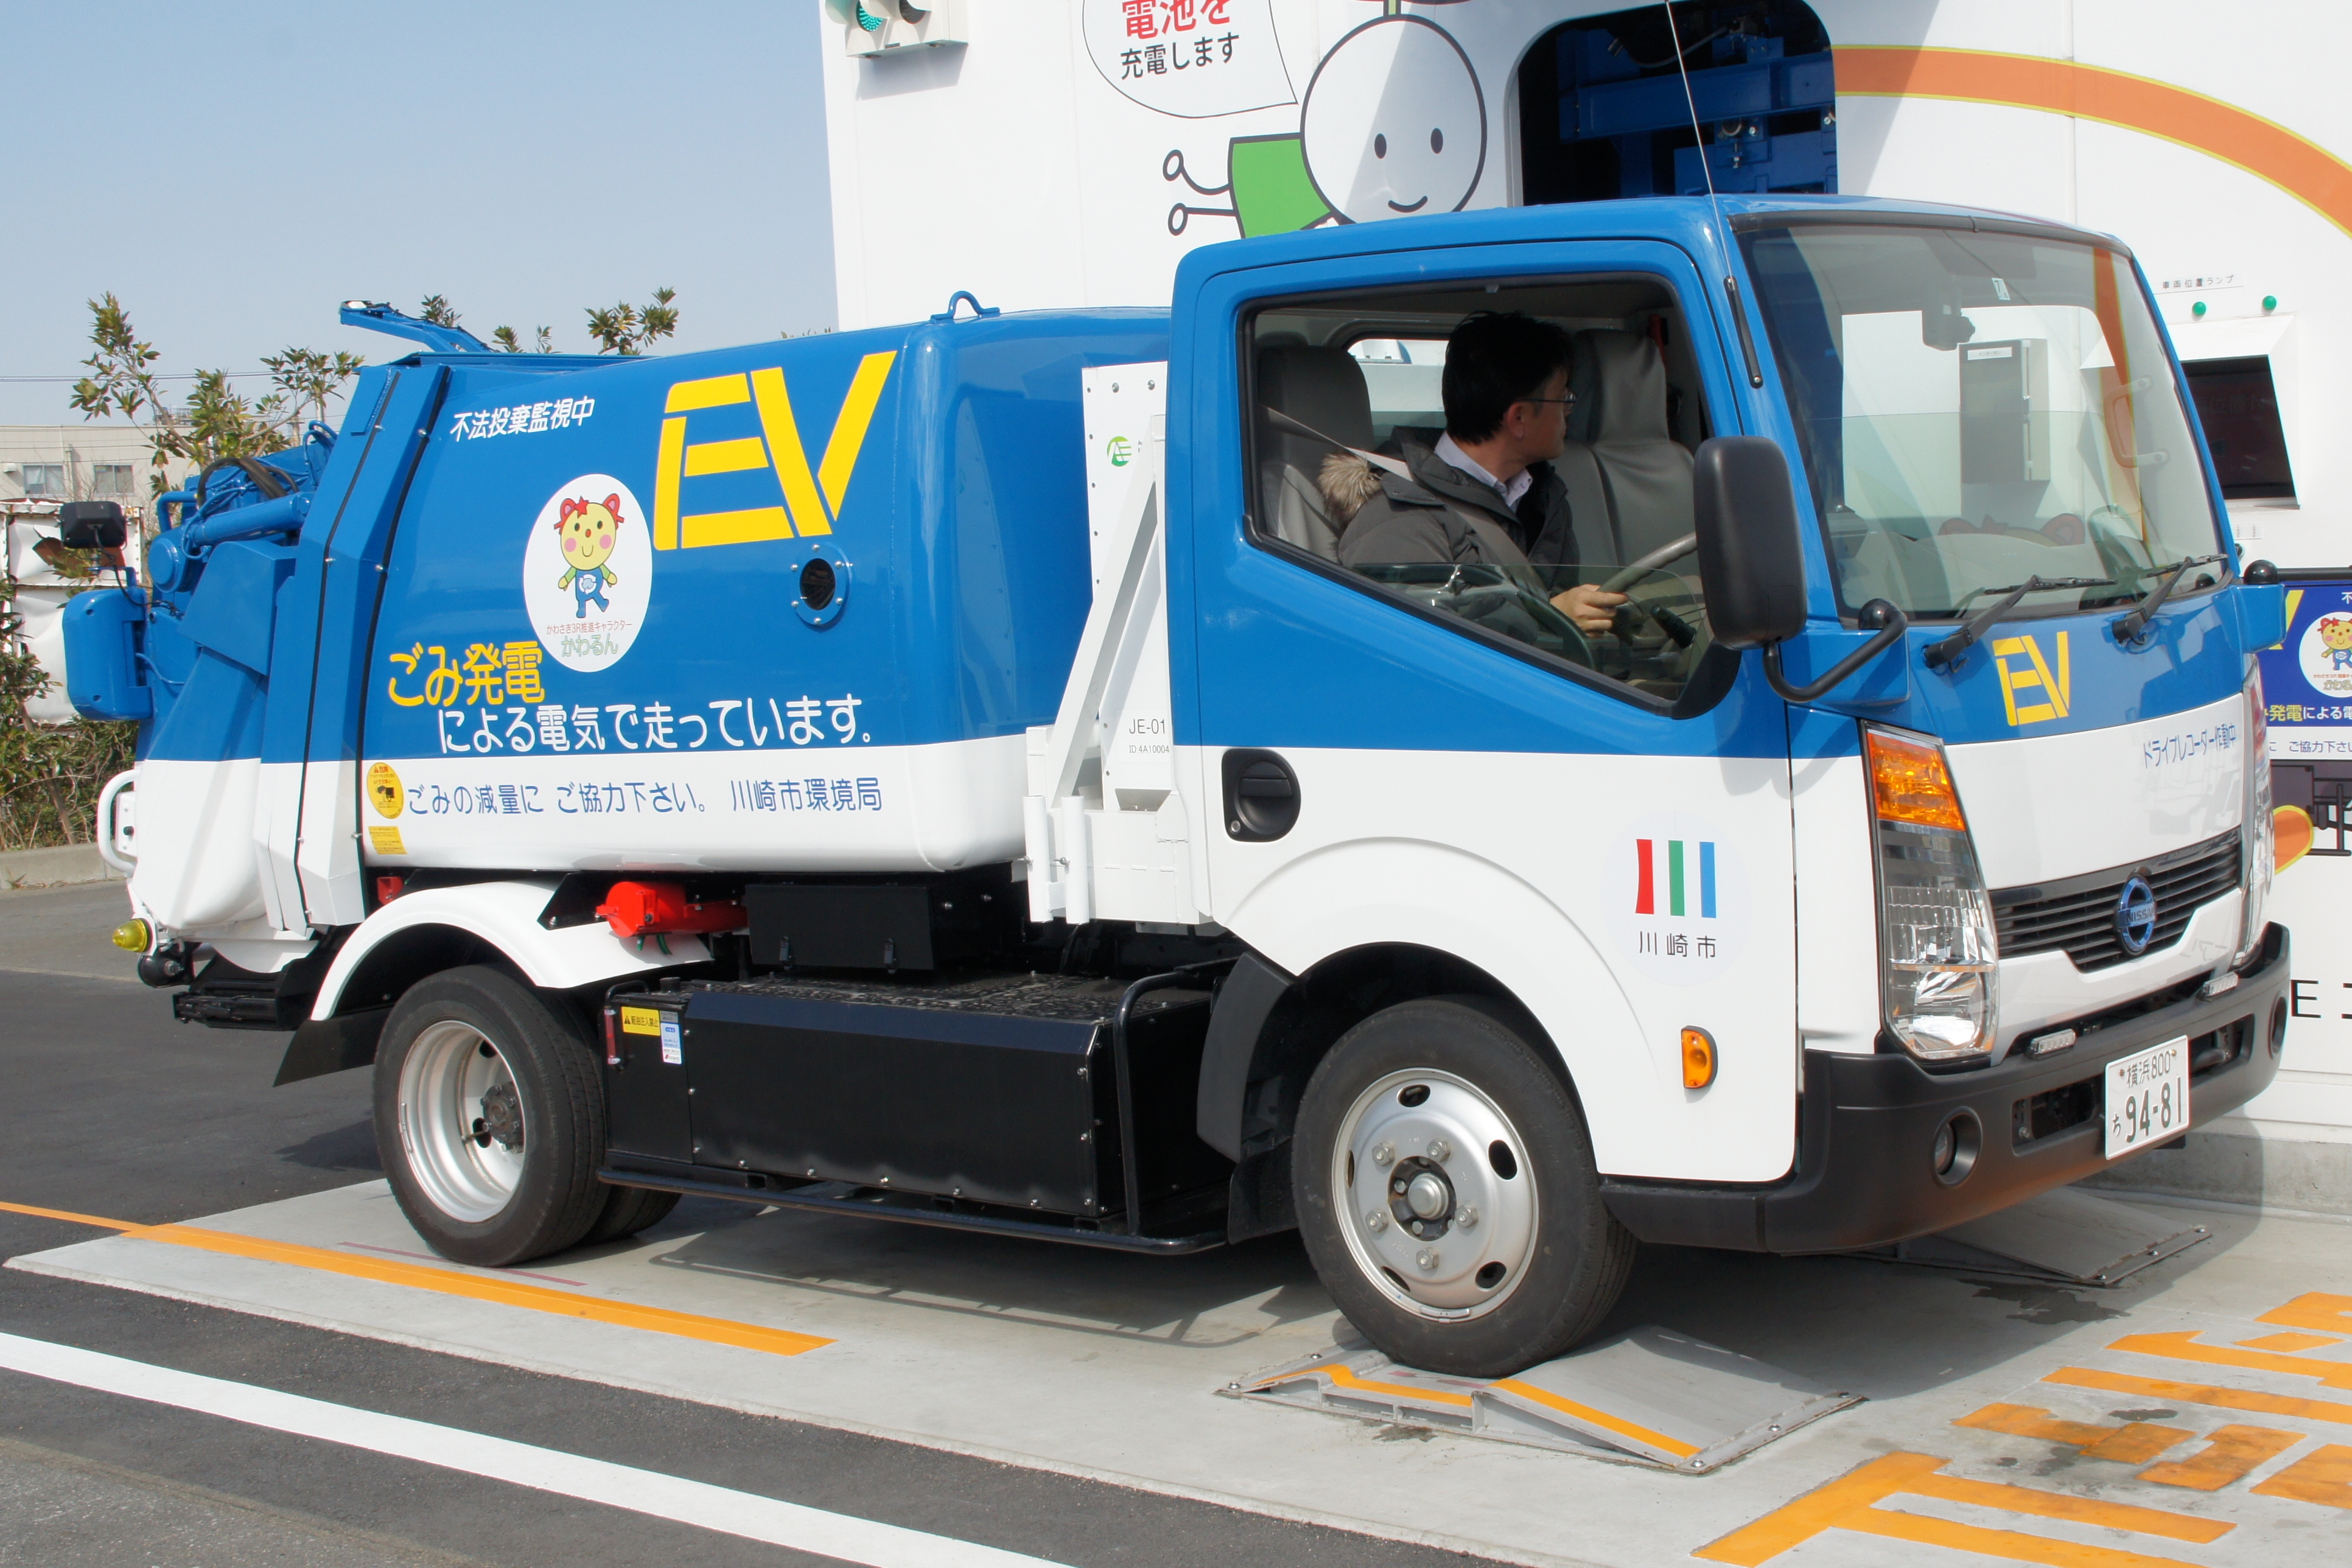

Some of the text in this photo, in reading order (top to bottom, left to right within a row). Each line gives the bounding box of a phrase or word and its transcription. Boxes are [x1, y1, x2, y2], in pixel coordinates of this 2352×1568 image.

[1121, 0, 1231, 40] 電池を
[1120, 32, 1240, 80] 充電します
[2162, 275, 2234, 289] 車両位置ランプ
[450, 396, 595, 442] 不法投棄監視中
[653, 350, 898, 550] EV
[546, 619, 633, 635] かわさき3R推進キャラクター
[561, 633, 619, 657] かわるん
[388, 641, 545, 707] ごみ発電
[1992, 631, 2070, 726] EV
[2323, 680, 2352, 691] かわる
[438, 693, 871, 754] による電気で走っています。
[1129, 718, 1166, 734] JE-01
[2264, 704, 2352, 722] 発電による電
[408, 777, 883, 814] ごみの減量に ご協力下さい。 川崎市環境局
[1639, 931, 1717, 959] 川崎市
[2125, 1076, 2182, 1143] 94-81
